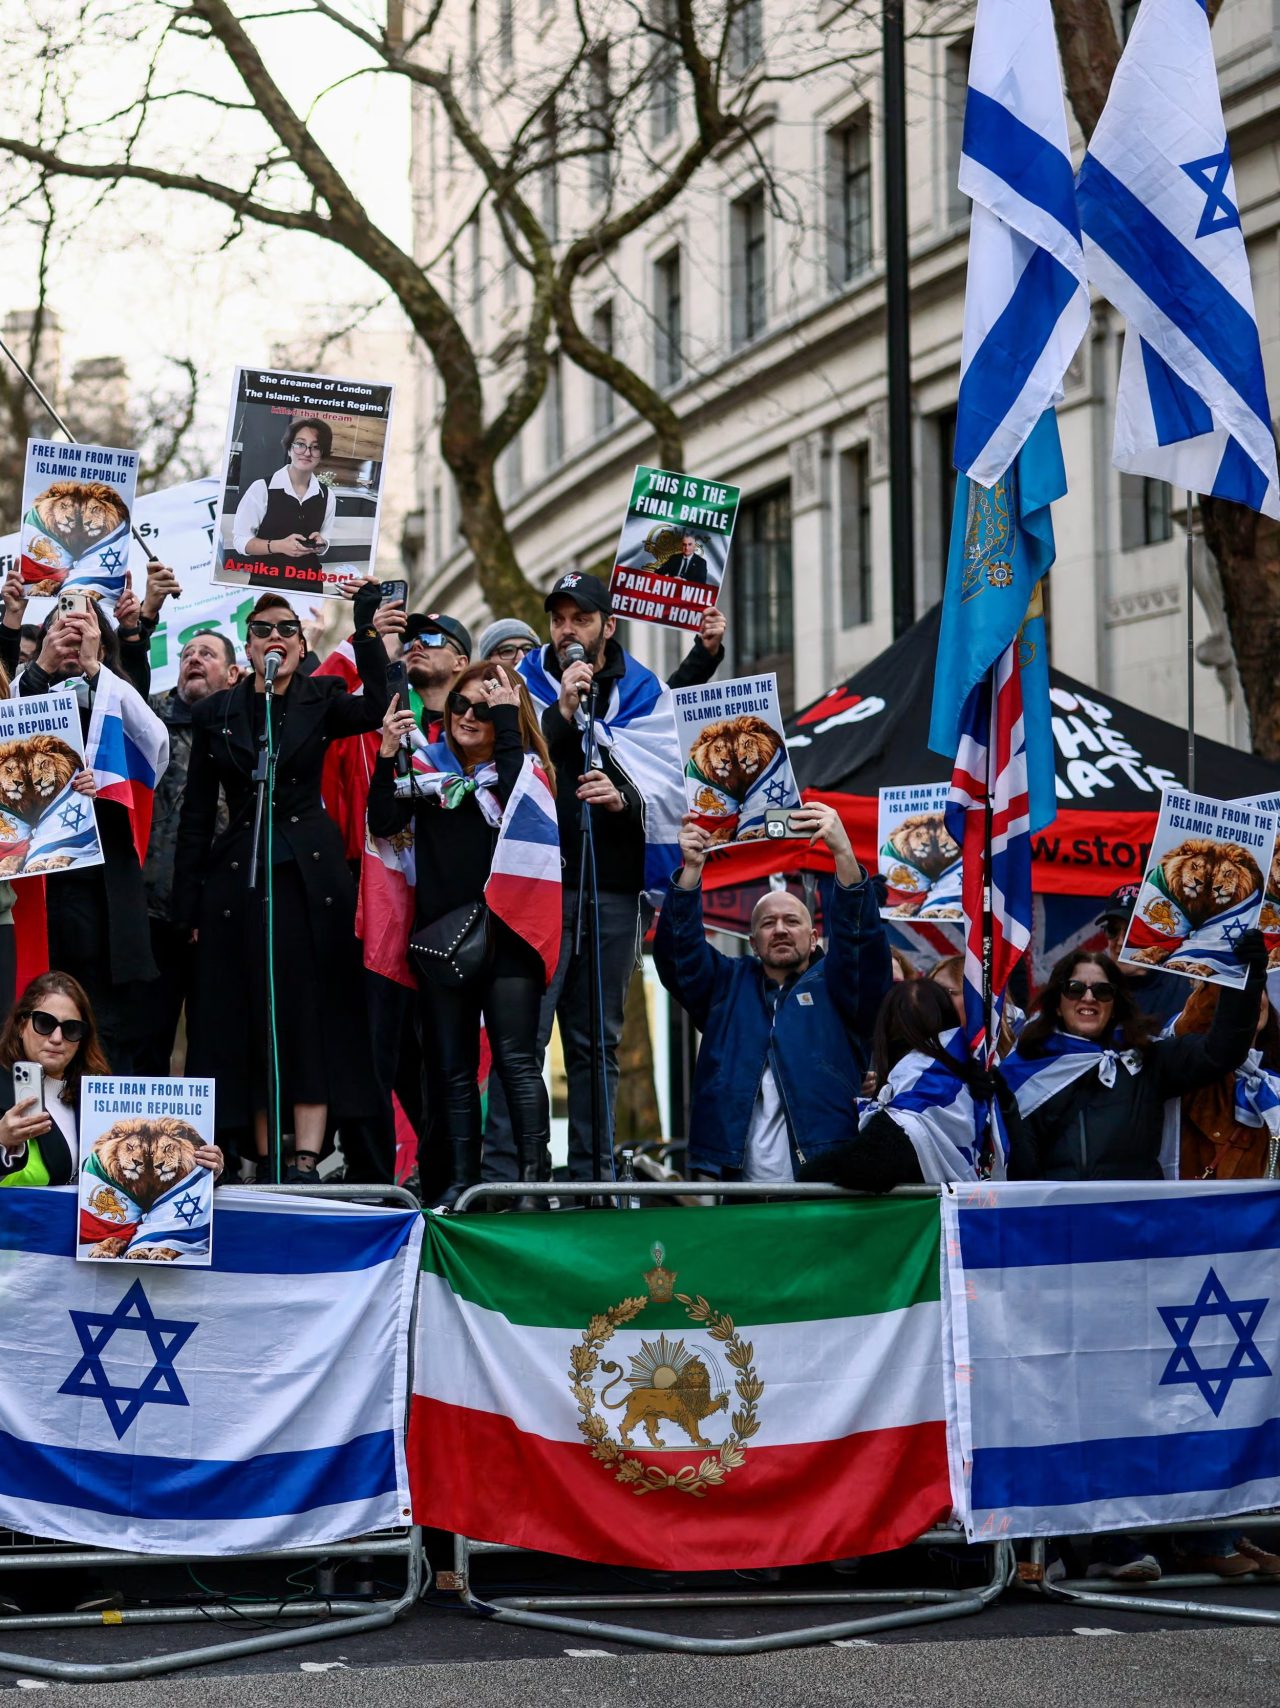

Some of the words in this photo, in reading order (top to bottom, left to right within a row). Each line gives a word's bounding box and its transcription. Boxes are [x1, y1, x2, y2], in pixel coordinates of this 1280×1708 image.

[259, 374, 277, 385] She
[280, 377, 322, 390] dreamed
[324, 382, 335, 391] of
[337, 383, 372, 395] London
[245, 389, 263, 399] The
[265, 391, 300, 403] Islamic
[303, 395, 345, 408] Terrorist
[347, 401, 383, 412] Regime
[271, 406, 297, 417] killed
[300, 409, 319, 419] that
[322, 411, 353, 422] dream
[32, 445, 55, 458] FREE
[59, 447, 82, 462] IRAN
[85, 451, 113, 465] FROM
[117, 455, 135, 468] THE
[36, 462, 77, 477] ISLAMIC
[80, 468, 127, 483] REPUBLIC
[648, 473, 680, 494] THIS
[683, 481, 698, 498] IS
[702, 485, 727, 505] THE
[635, 496, 674, 518] FINAL
[679, 504, 729, 530] BATTLE
[224, 558, 279, 577] Arnika
[616, 572, 676, 598] PAHLAVI
[681, 585, 713, 607] WILL
[611, 594, 664, 619] RETURN
[669, 606, 703, 627] HOM
[676, 690, 699, 706] FREE
[700, 687, 723, 703] IRAN
[725, 683, 753, 699] FROM
[755, 680, 773, 693] THE
[19, 701, 49, 718] FROM
[52, 697, 73, 713] THE
[683, 706, 723, 722] ISLAMIC
[725, 698, 770, 716] REPUBLIC
[18, 716, 69, 735] REPUBLIC
[1051, 715, 1142, 759] HE
[1055, 755, 1189, 800] ATE
[884, 791, 906, 800] FREE
[910, 789, 932, 799] IRAN
[936, 787, 950, 797] FR
[889, 801, 929, 813] ISLAMIC
[1167, 794, 1191, 812] FREE
[1194, 801, 1218, 818] IRAN
[1221, 807, 1250, 826] FROM
[1255, 815, 1273, 831] THE
[1169, 814, 1213, 835] ISLAMIC
[1216, 824, 1264, 847] REPUBLIC
[87, 1081, 116, 1096] FREE
[119, 1082, 146, 1096] IRAN
[151, 1082, 184, 1097] FROM
[189, 1084, 209, 1098] THE
[94, 1099, 143, 1114] ISLAMIC
[147, 1100, 202, 1116] REPUBLIC
